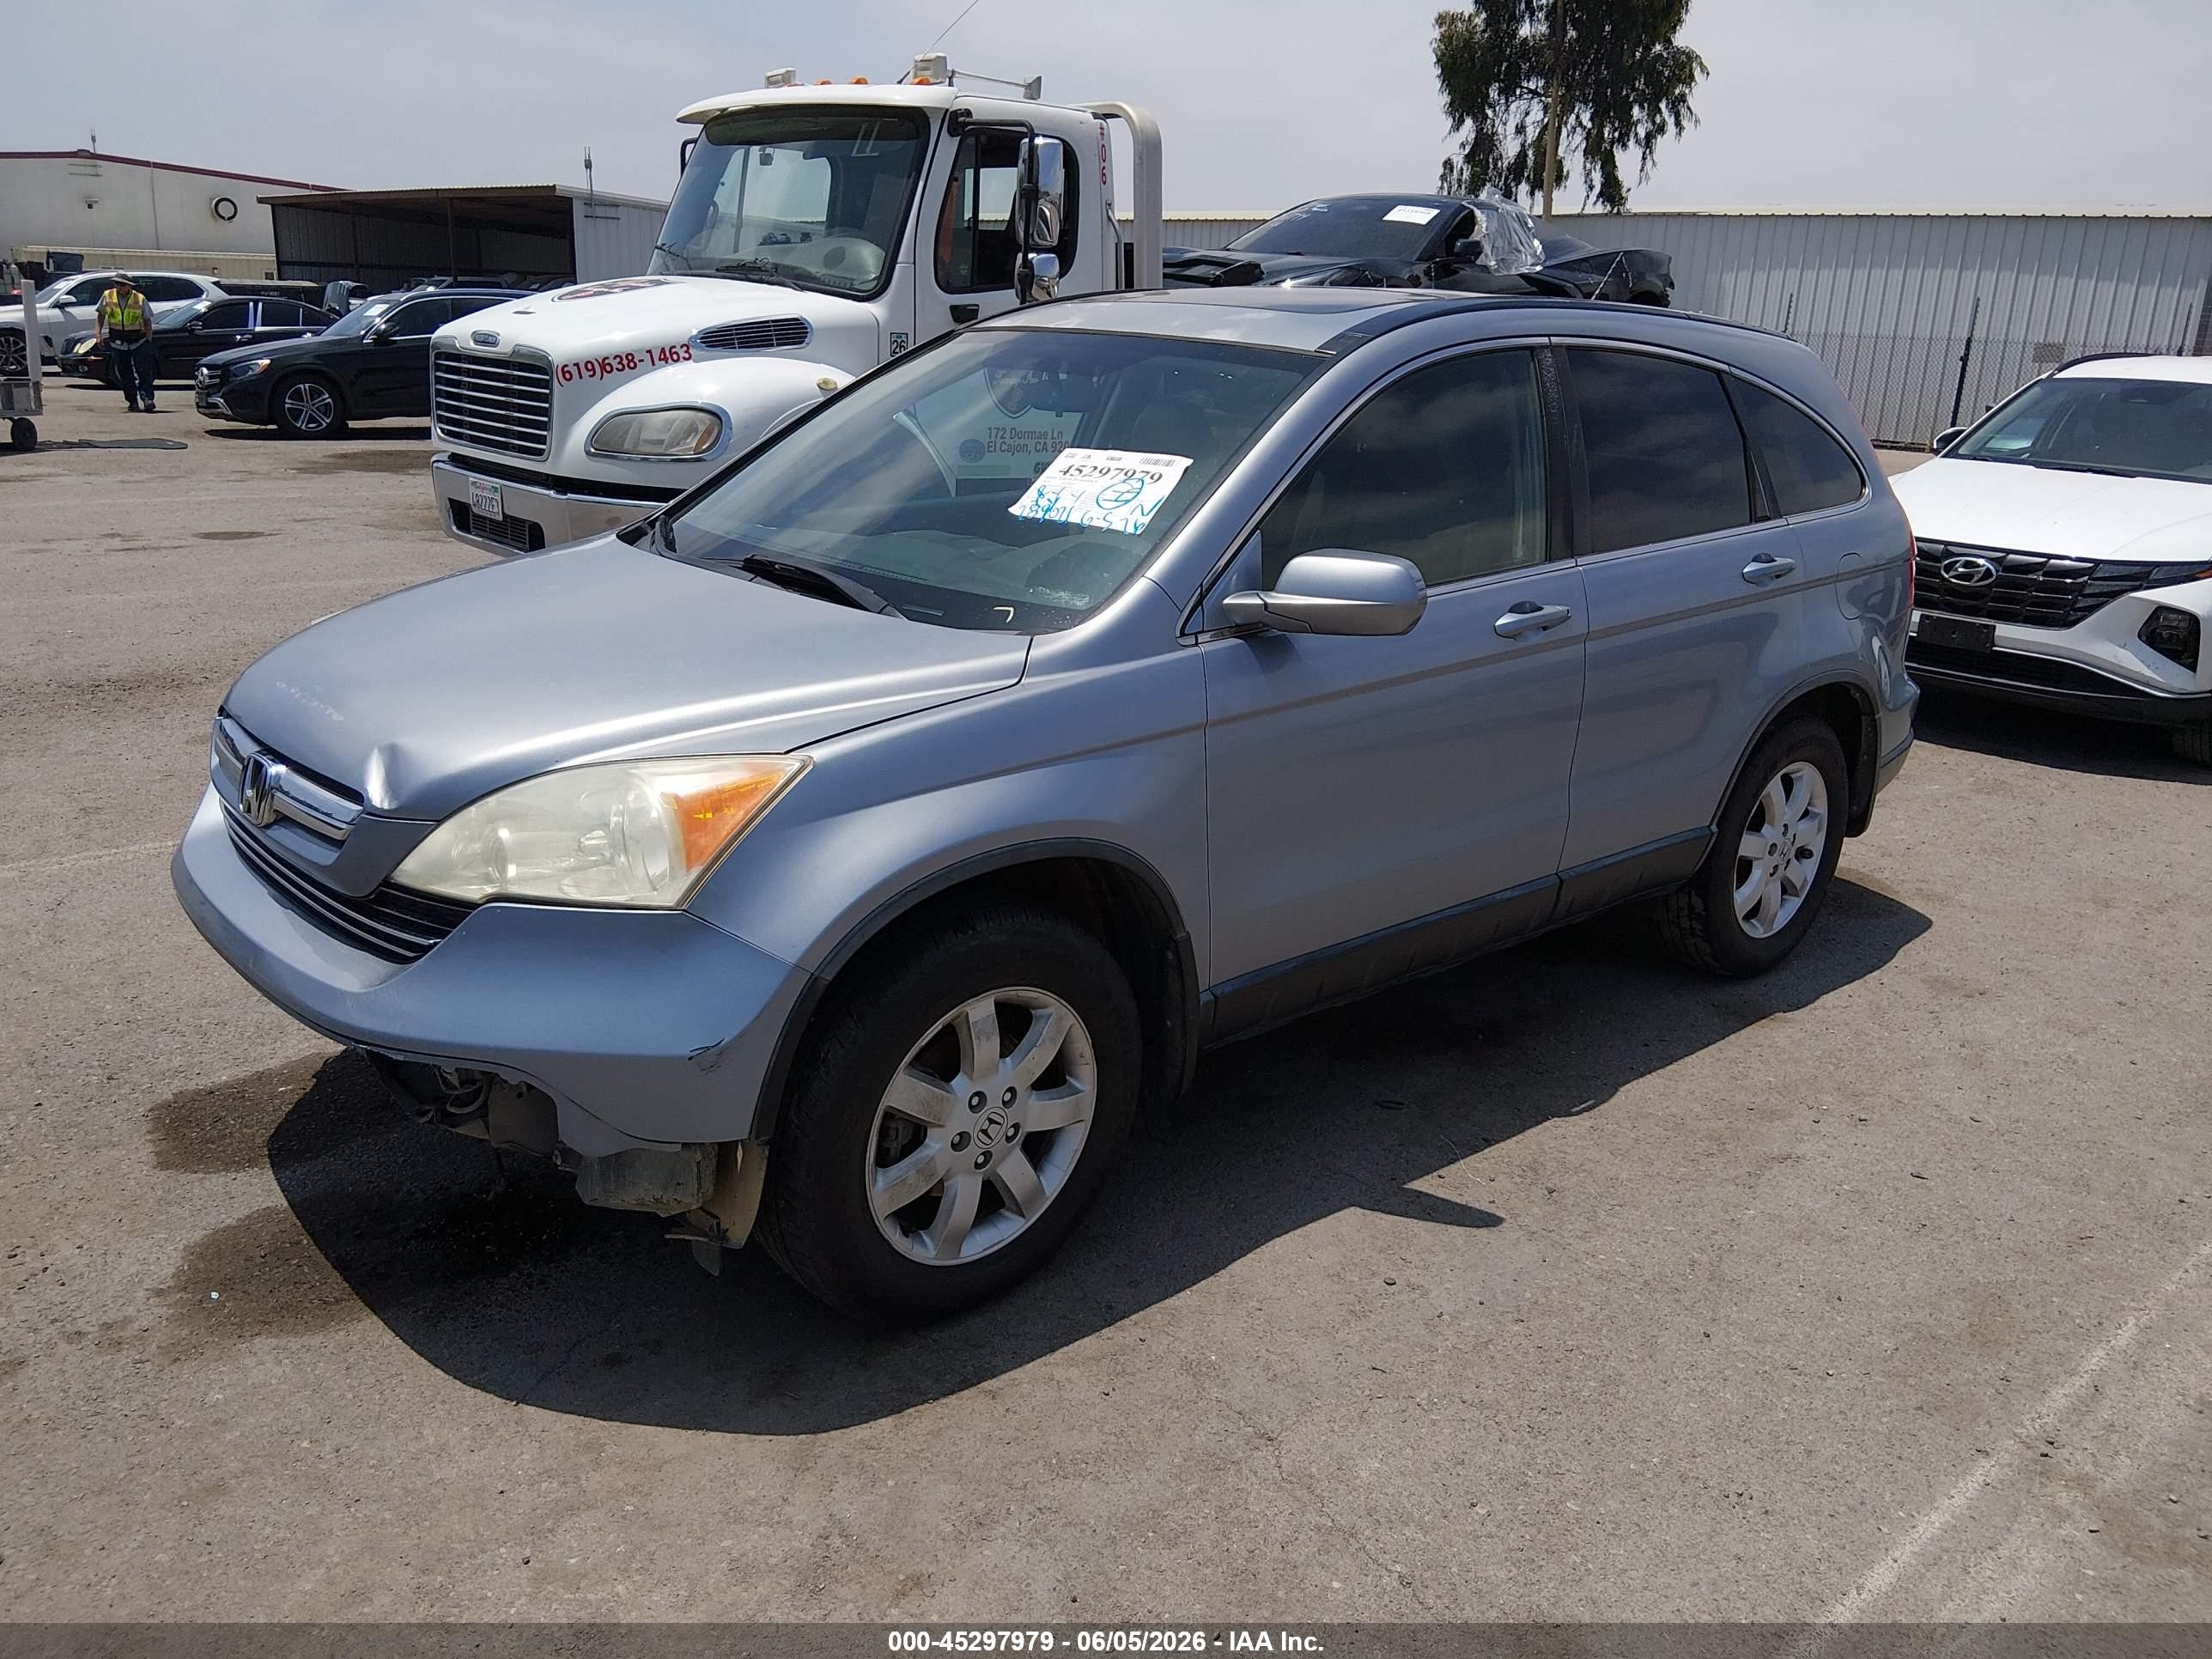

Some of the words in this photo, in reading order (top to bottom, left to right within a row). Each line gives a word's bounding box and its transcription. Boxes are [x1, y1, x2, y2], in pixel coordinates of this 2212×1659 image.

[892, 339, 907, 354] 26
[556, 343, 693, 387] (619)638-1463
[988, 427, 1006, 440] 172
[1009, 427, 1048, 440] Dormae
[1051, 428, 1063, 440] Ln
[988, 441, 996, 453] El
[1000, 441, 1031, 456] Cajon,
[1034, 441, 1048, 453] CA
[1058, 465, 1164, 484] 45297979
